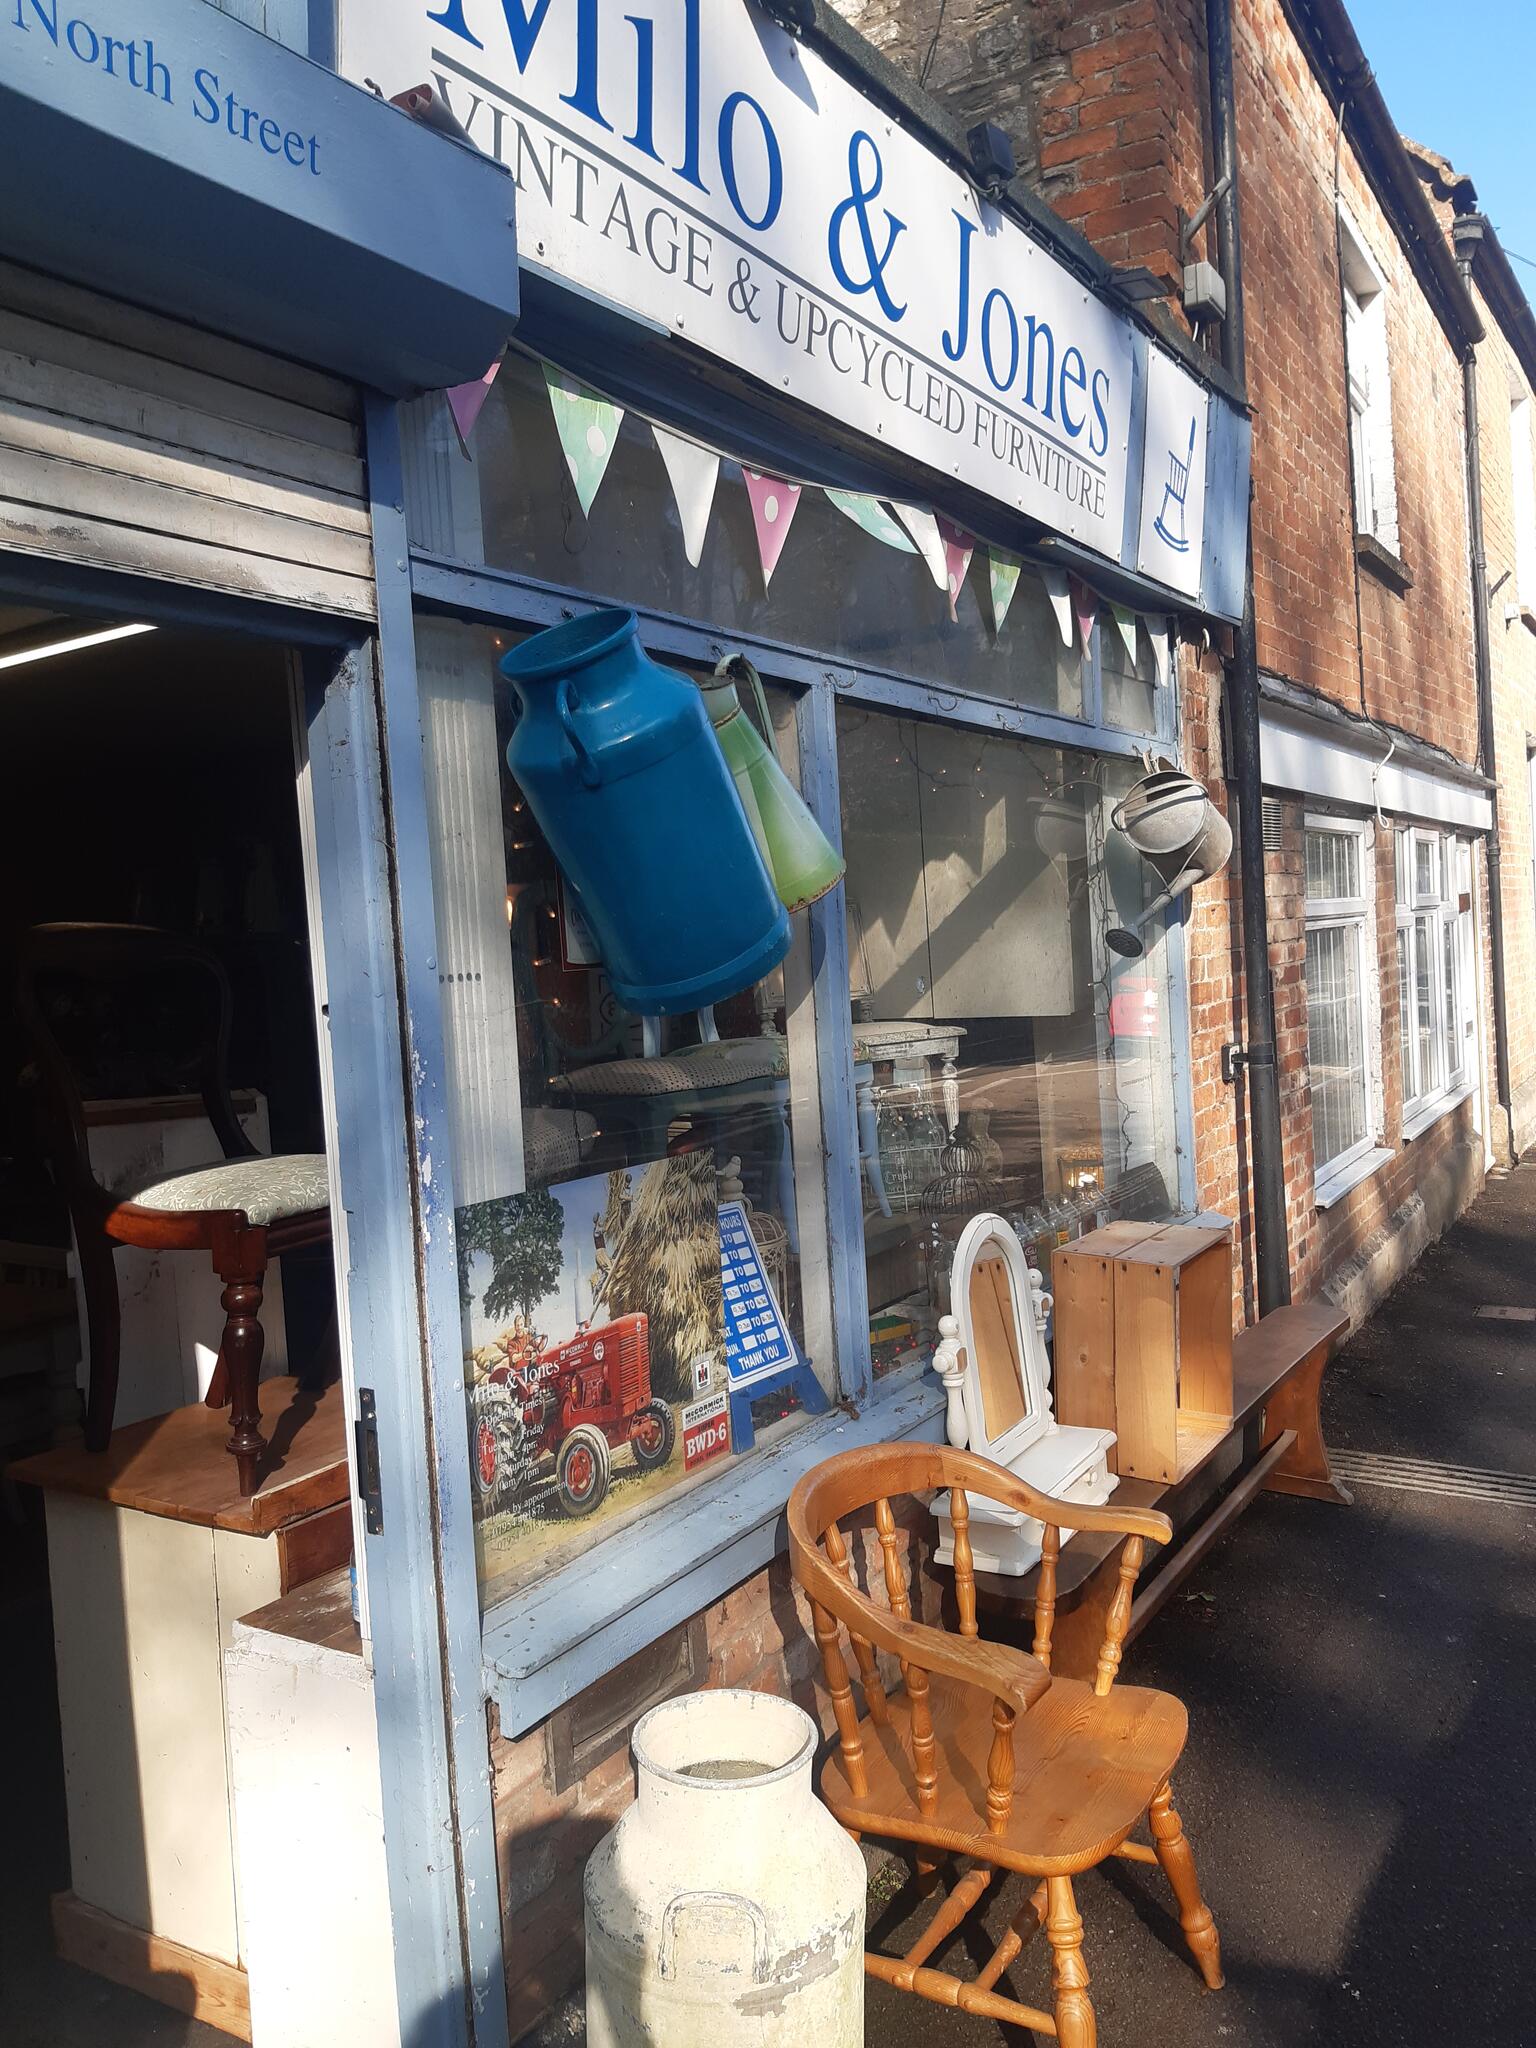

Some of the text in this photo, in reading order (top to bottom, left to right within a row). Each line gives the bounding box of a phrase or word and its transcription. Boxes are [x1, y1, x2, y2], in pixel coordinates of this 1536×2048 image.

[12, 0, 321, 176] North Street
[430, 70, 1106, 520] VINTAGE & UPCYCLED FURNITURE
[828, 130, 907, 322] &
[942, 208, 1110, 457] Jones
[722, 1234, 732, 1244] TO
[728, 1250, 738, 1260] TO
[734, 1267, 744, 1277] TO
[739, 1283, 749, 1293] TO
[745, 1299, 755, 1310] TO
[751, 1316, 760, 1327] TO
[756, 1333, 767, 1344] TO
[738, 1344, 779, 1370] THANK YOU
[505, 1370, 518, 1391] &
[521, 1360, 560, 1383] Jones
[685, 1396, 724, 1419] McCORMICK
[512, 1502, 522, 1514] by
